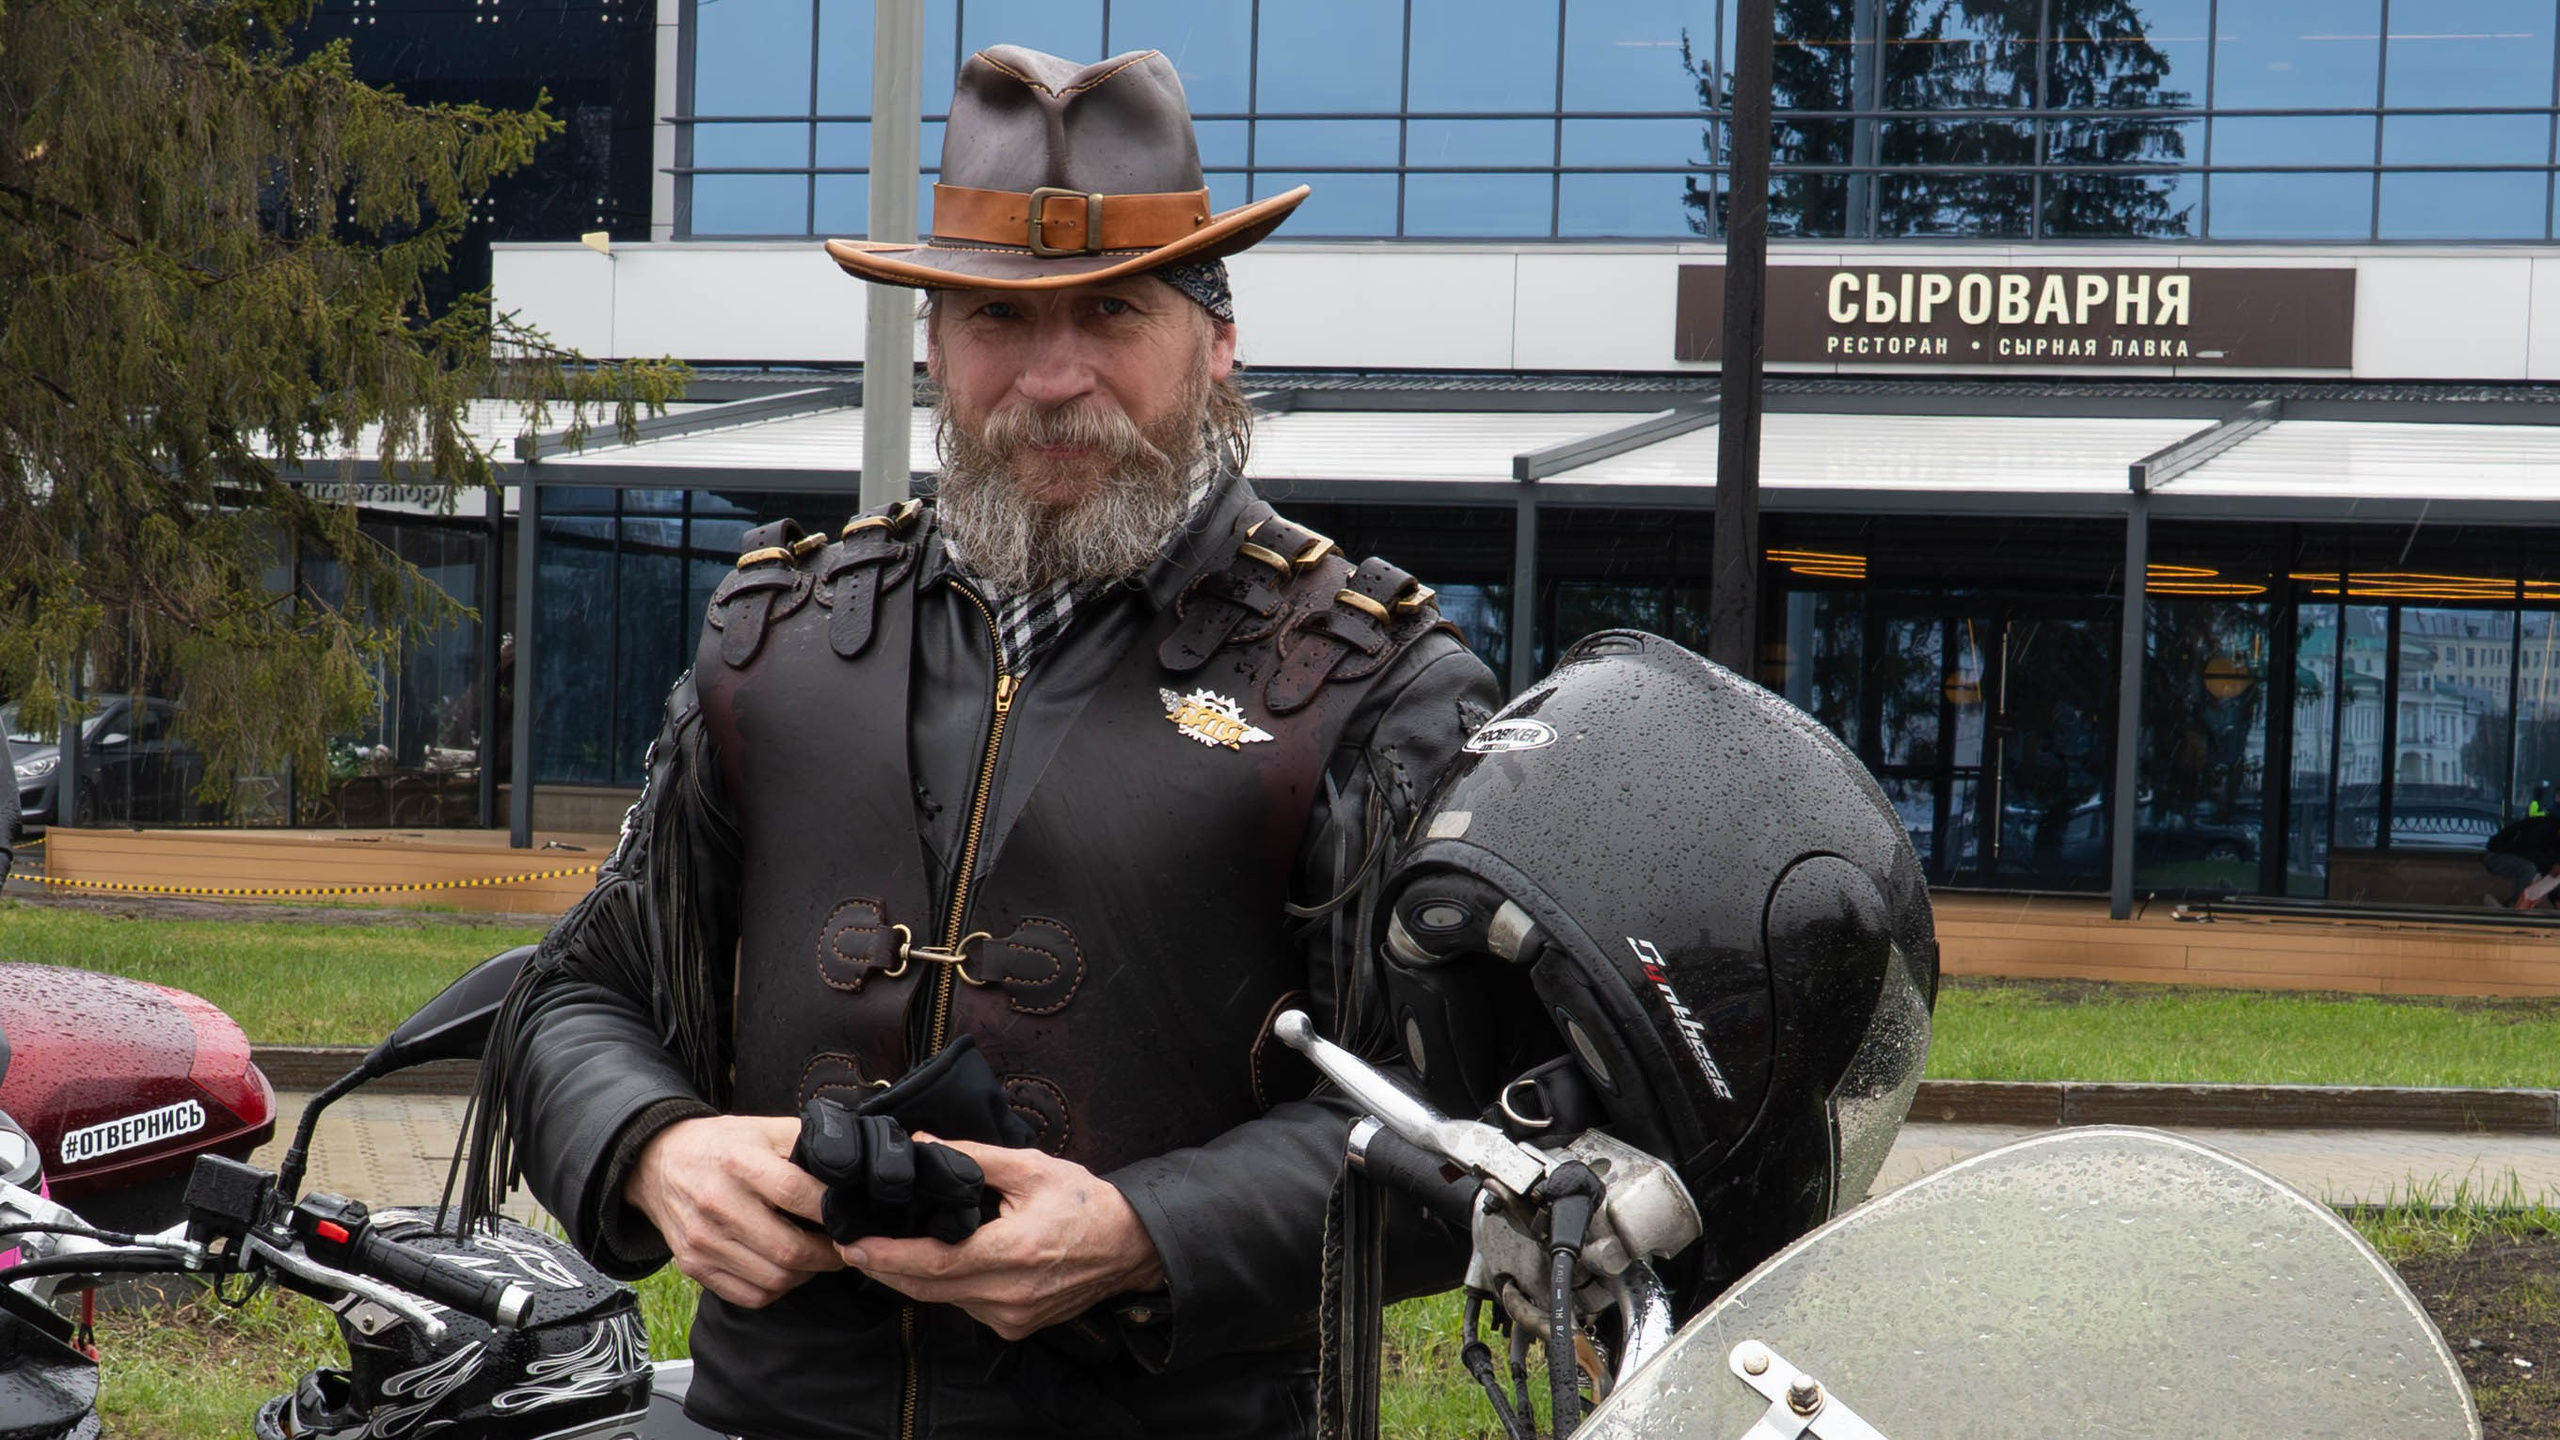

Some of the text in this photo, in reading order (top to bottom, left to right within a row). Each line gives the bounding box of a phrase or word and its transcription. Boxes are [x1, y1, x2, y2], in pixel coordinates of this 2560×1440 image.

[1828, 272, 2190, 325] СЫРОВАРНЯ
[1827, 336, 2189, 358] РЕСТОРАН СЫРНАЯ ЛАВКА
[66, 1103, 202, 1160] #ОТВЕРНИСЬ
